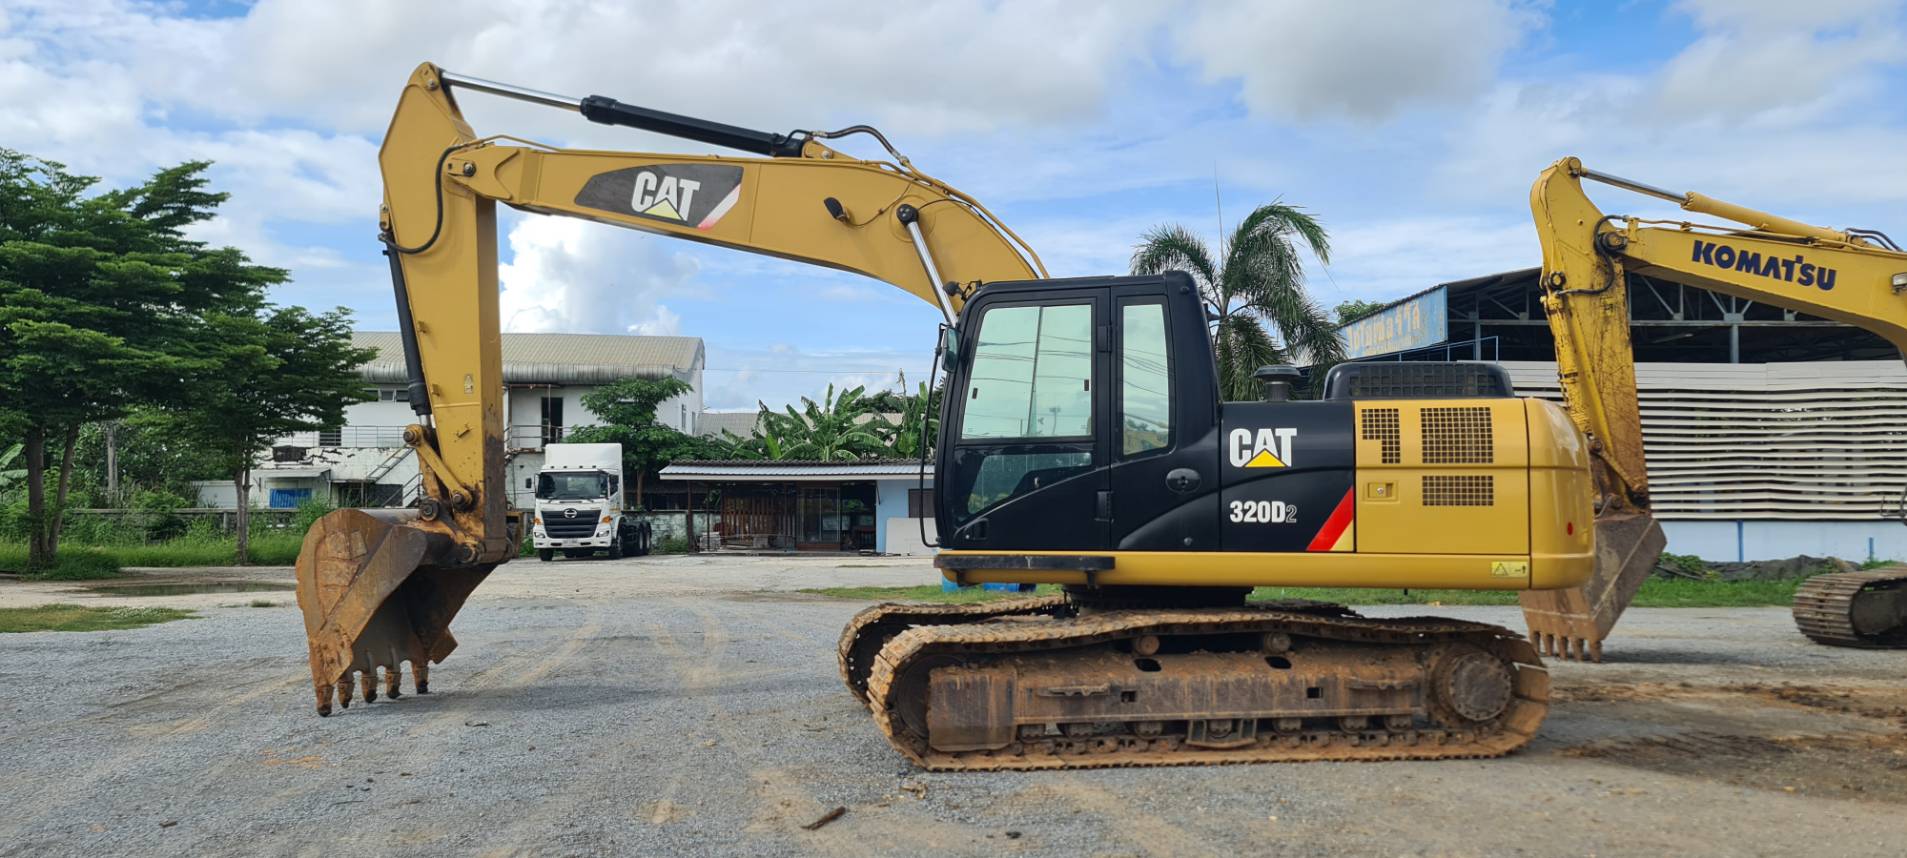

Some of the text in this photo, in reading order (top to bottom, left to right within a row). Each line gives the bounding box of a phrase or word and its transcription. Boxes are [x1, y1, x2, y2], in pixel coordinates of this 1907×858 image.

[631, 171, 701, 221] CAT
[1229, 428, 1298, 468] CAT
[1229, 500, 1297, 523] 320D2
